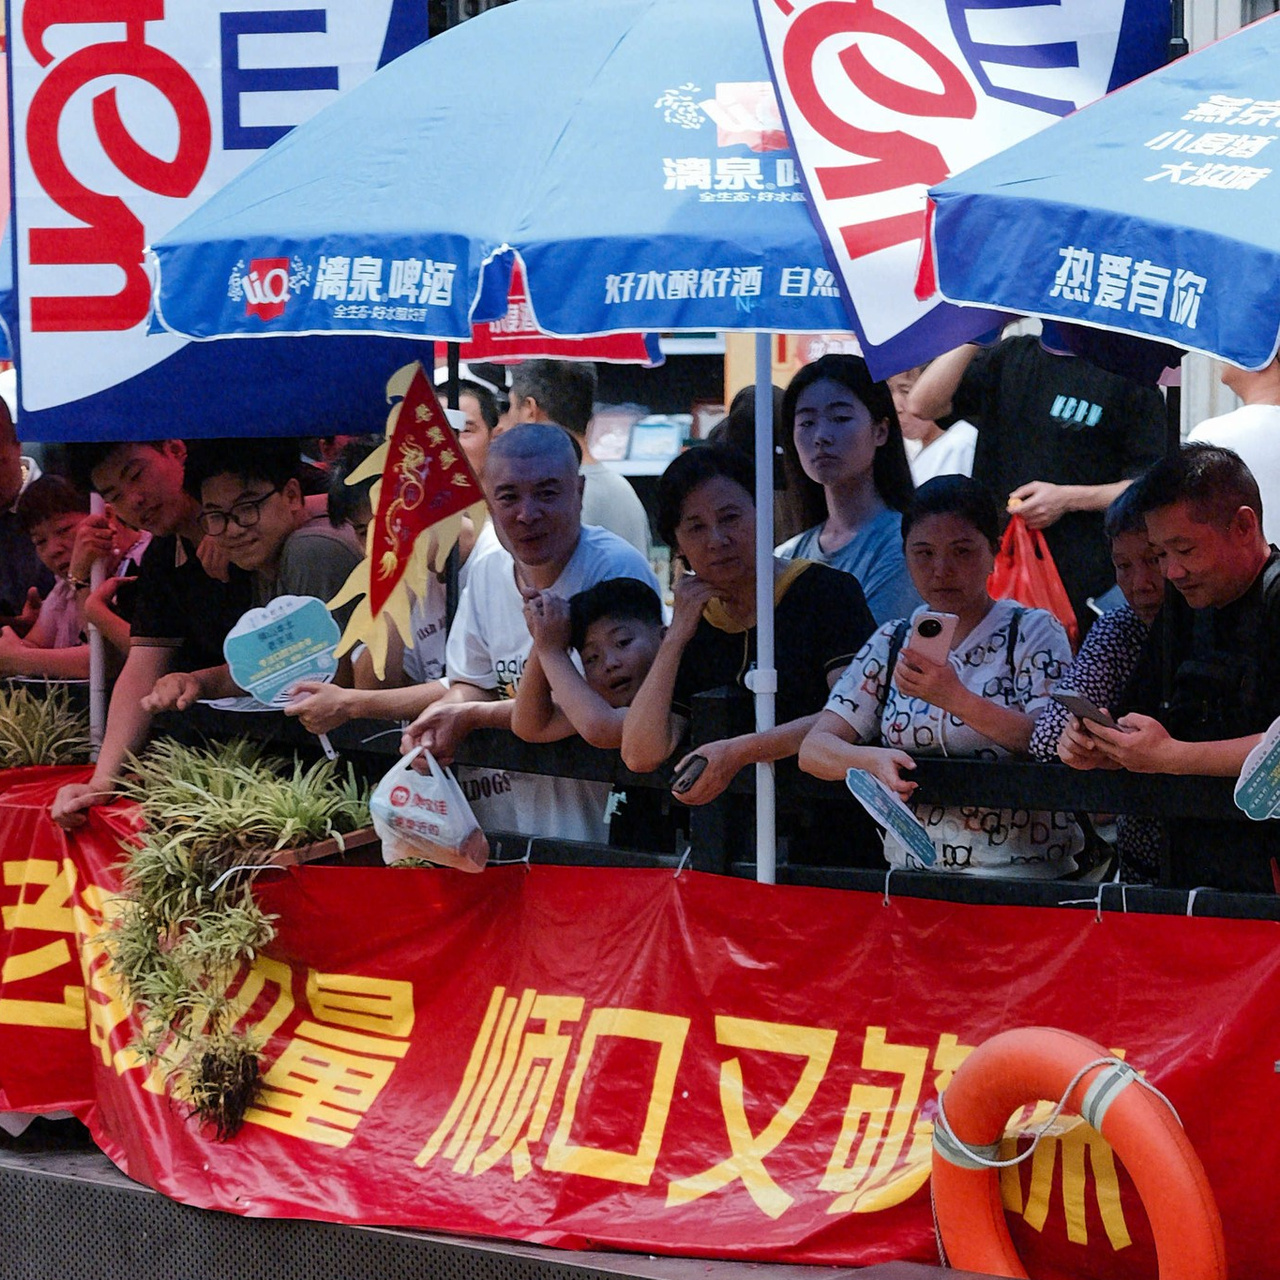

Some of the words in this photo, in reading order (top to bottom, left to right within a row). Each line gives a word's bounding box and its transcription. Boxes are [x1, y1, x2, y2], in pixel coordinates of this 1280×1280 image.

[604, 265, 764, 305] 好水酿好酒
[1049, 246, 1208, 329] 热爱有你
